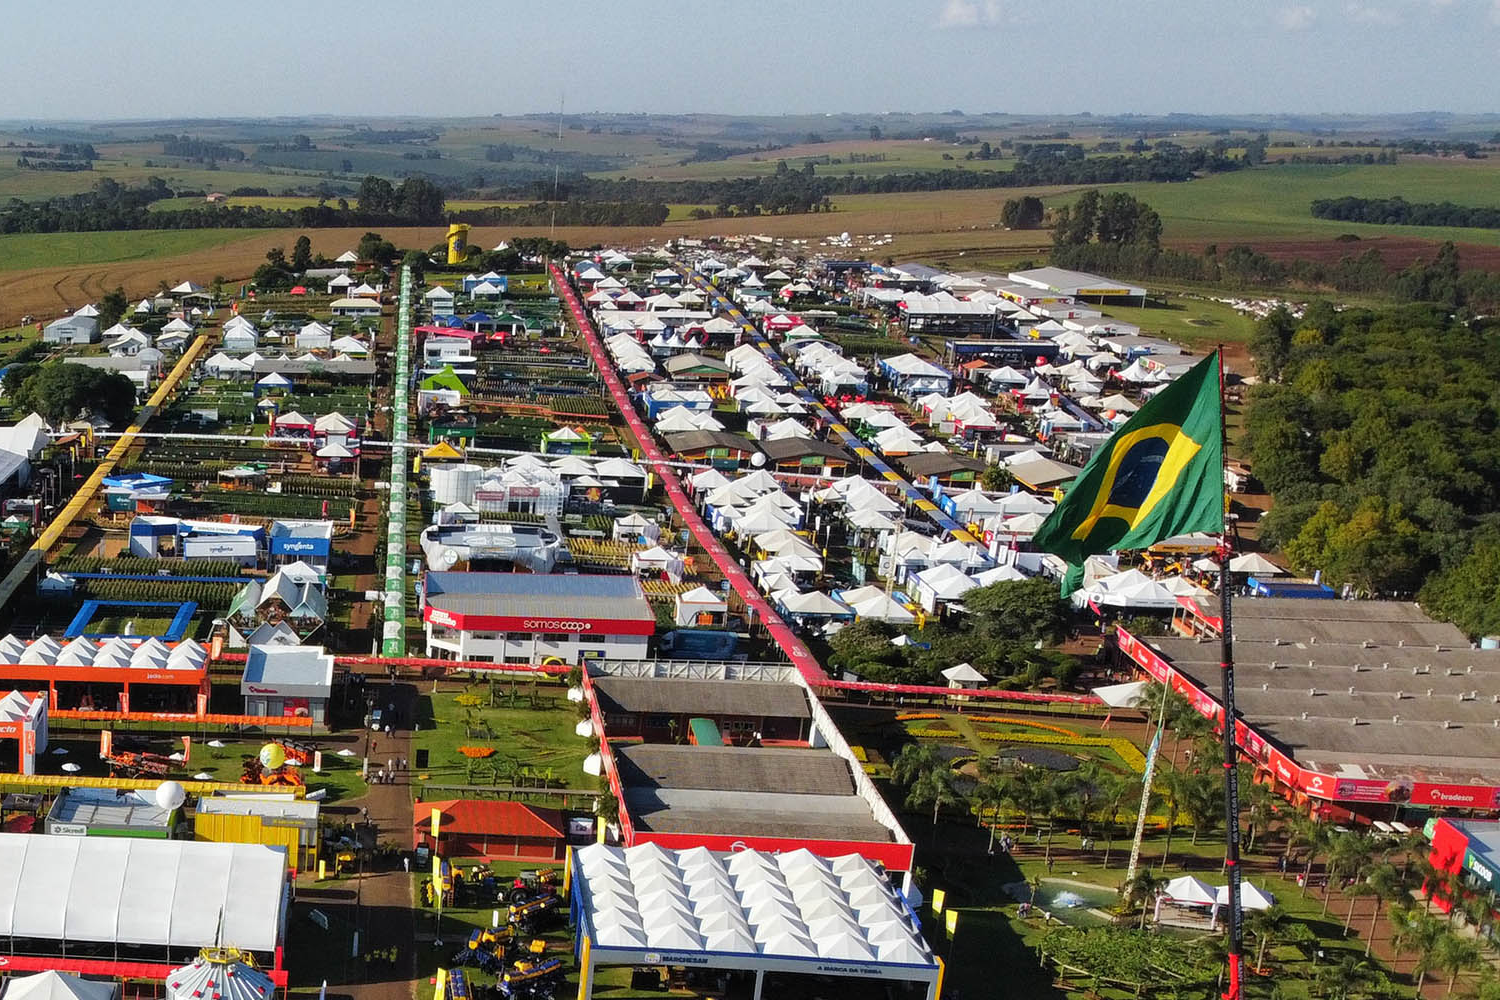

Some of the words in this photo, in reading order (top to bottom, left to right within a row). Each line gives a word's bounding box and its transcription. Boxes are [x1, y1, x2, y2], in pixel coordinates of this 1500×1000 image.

[284, 541, 314, 551] syngenta
[1441, 792, 1474, 802] bradesco
[62, 826, 86, 834] Sicredi
[662, 956, 708, 965] MARCHESAN
